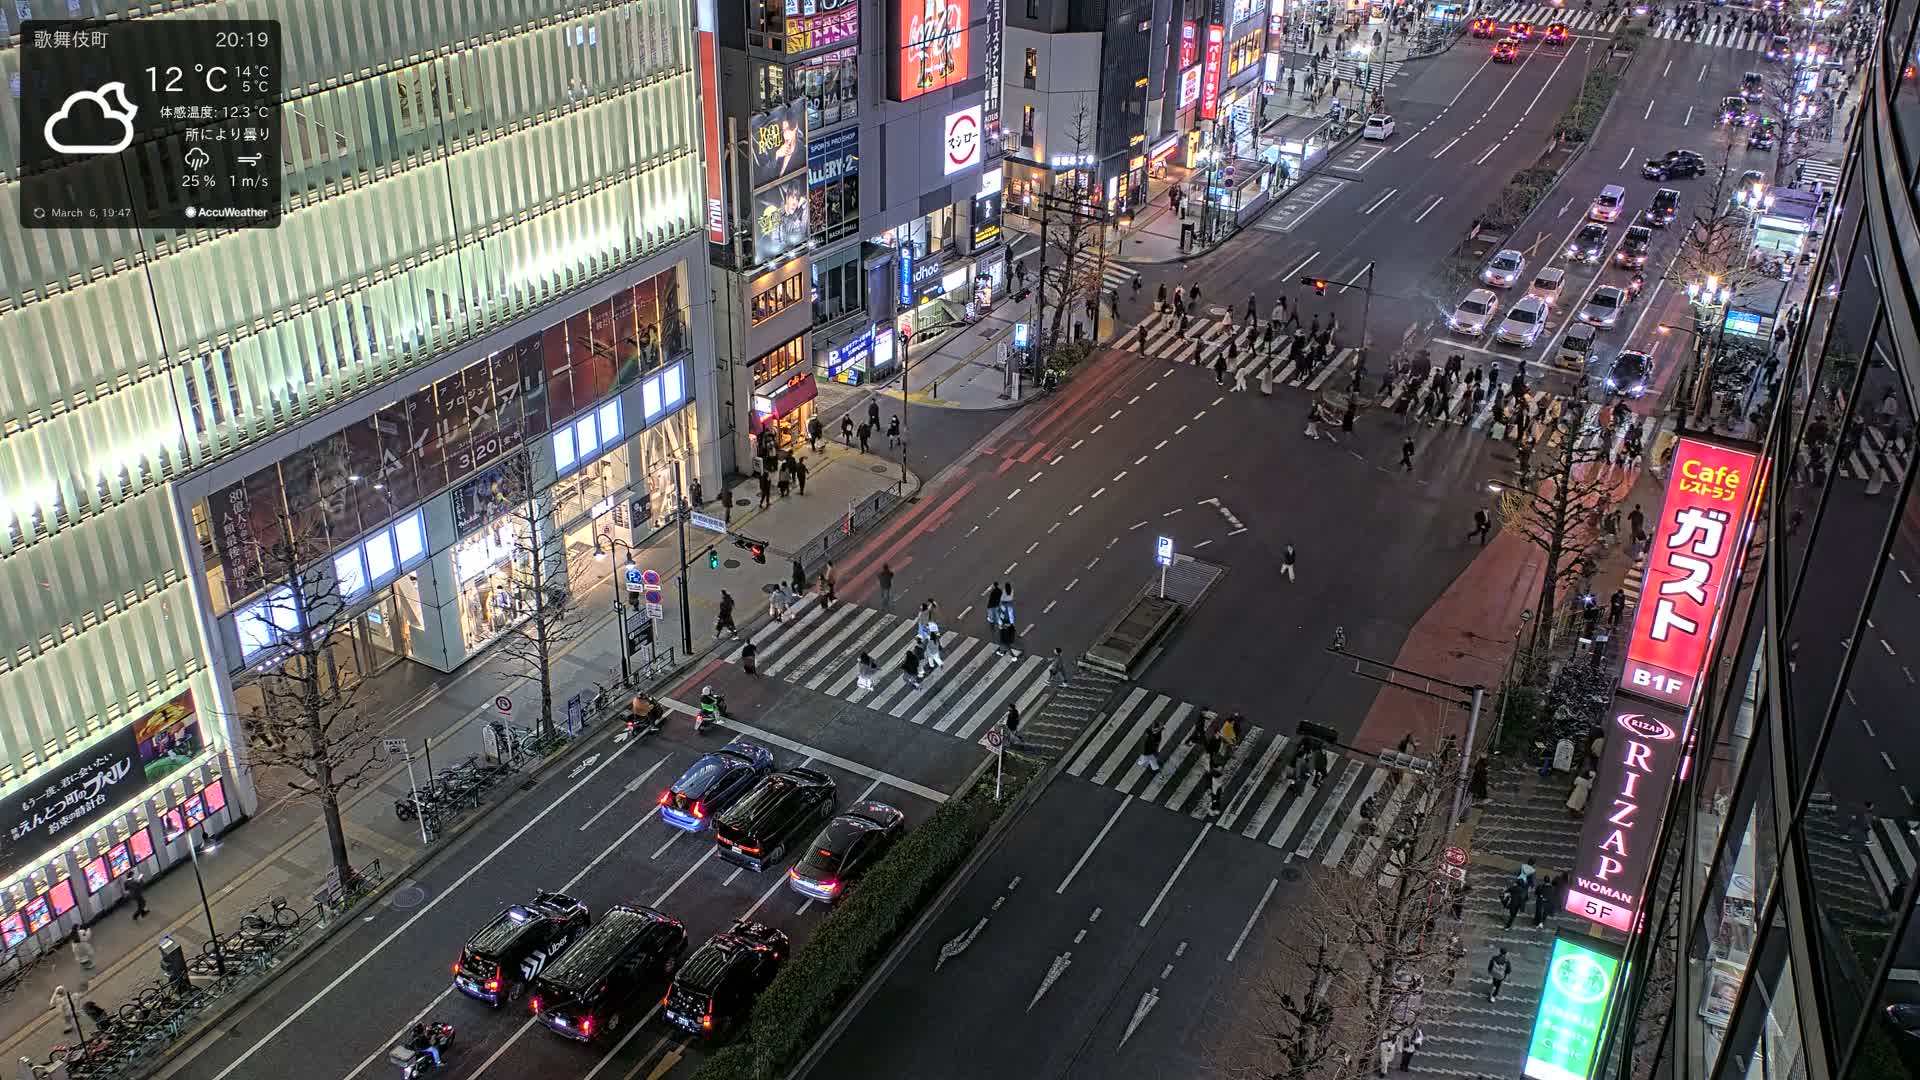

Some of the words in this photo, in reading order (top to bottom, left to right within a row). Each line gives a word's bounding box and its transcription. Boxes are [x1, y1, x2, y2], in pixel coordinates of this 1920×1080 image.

[1205, 45, 1219, 110] バーガーキング
[709, 198, 722, 232] MUJI
[446, 377, 503, 411] プロジェクト
[1681, 459, 1740, 489] Café
[1679, 480, 1736, 502] レストラン
[1160, 539, 1168, 547] P
[1650, 508, 1727, 640] ガスト
[1632, 668, 1684, 694] B1F
[1631, 719, 1664, 734] RIZAP
[19, 757, 131, 836] えんとつ町のプペル
[22, 753, 113, 811] もう一度、君に会いたい
[48, 794, 106, 835] 約束の時計台
[1596, 740, 1653, 881] RIZAP
[1577, 877, 1632, 904] WOMAN
[1585, 901, 1613, 919] 5F
[547, 935, 567, 956] Uber
